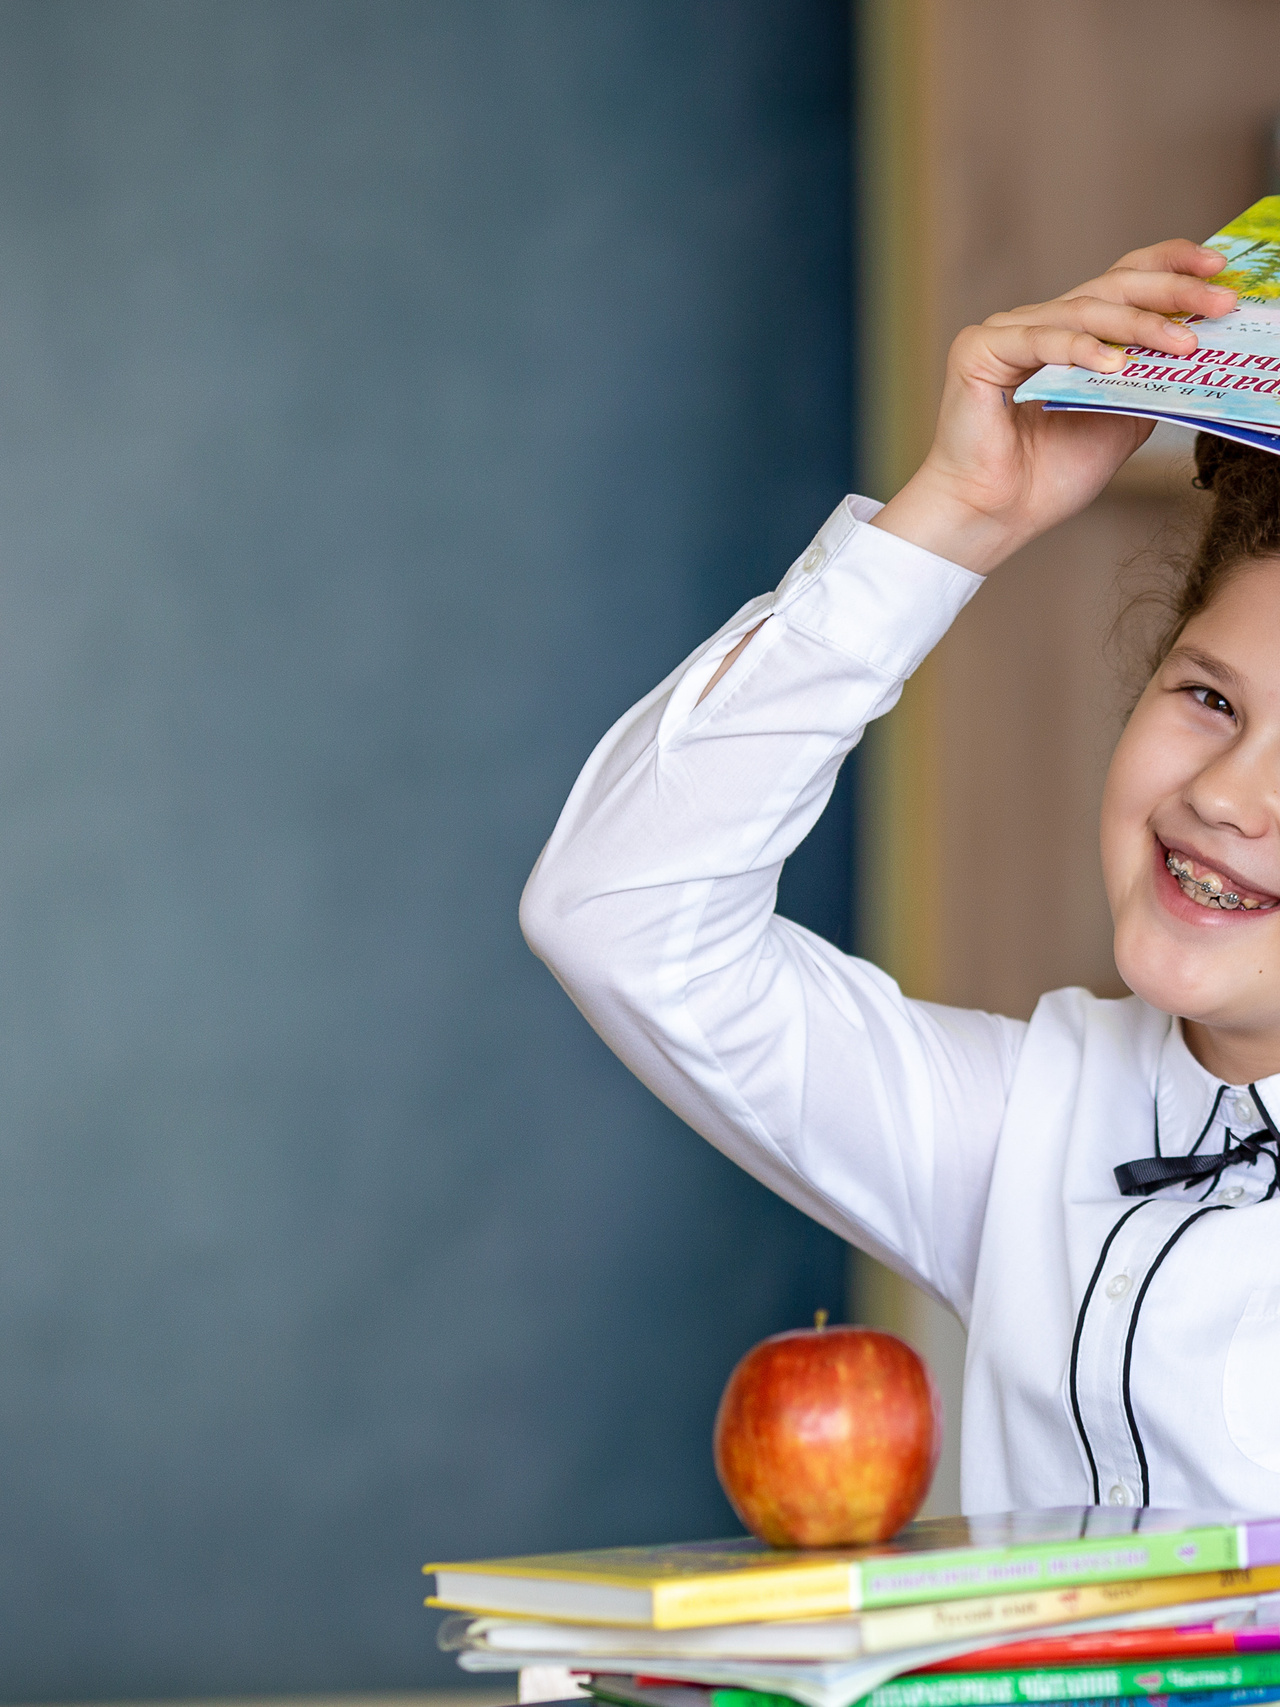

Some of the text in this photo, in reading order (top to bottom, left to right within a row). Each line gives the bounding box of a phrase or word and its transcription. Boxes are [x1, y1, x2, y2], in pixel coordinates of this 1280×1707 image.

[1086, 377, 1228, 399] М. В. Жуковіч
